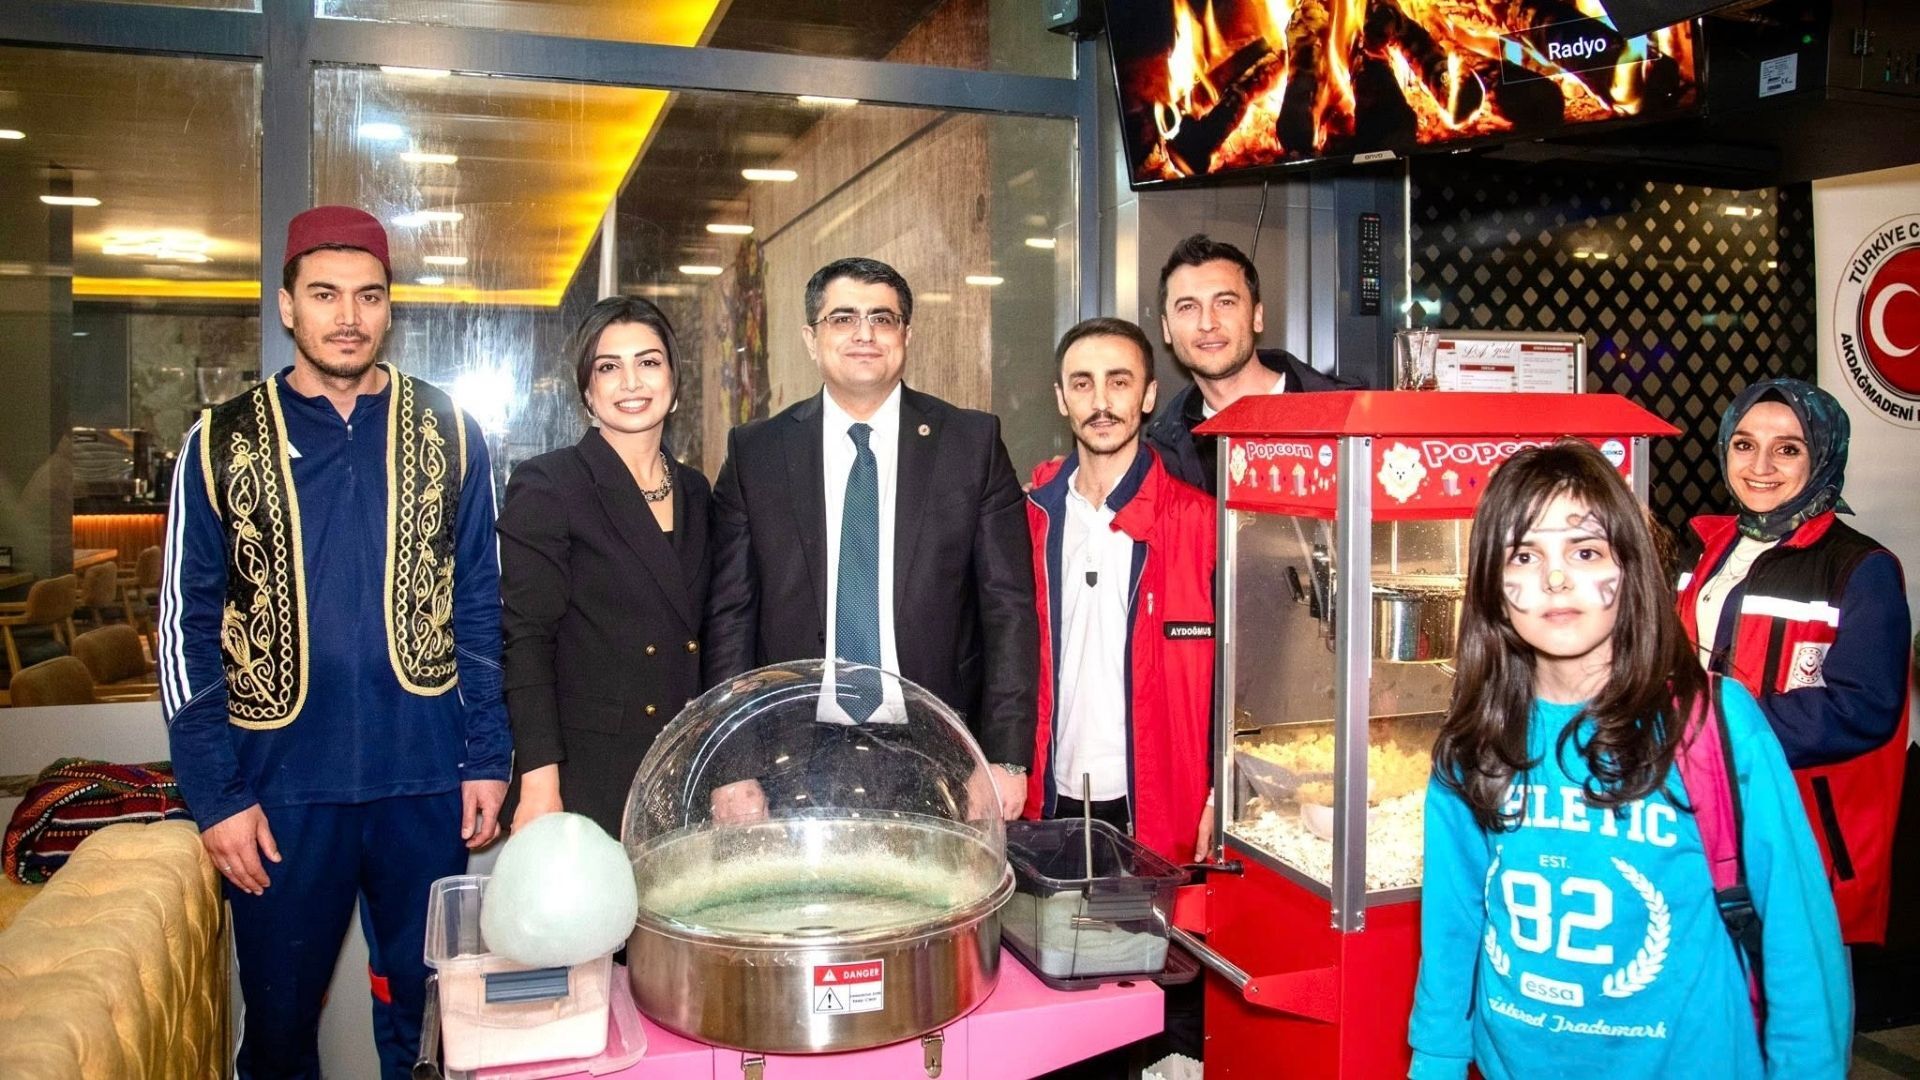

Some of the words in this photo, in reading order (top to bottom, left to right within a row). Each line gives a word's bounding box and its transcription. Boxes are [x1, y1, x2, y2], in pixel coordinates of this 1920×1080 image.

[1548, 36, 1606, 60] Radyo
[1849, 225, 1906, 285] TÜRKİYE
[1841, 332, 1913, 421] AKDAĞMADENİ
[1246, 441, 1313, 461] Popcorn
[1539, 854, 1570, 868] EST.
[1501, 869, 1614, 964] 82
[843, 968, 880, 979] DANGER
[1525, 979, 1574, 1000] essa
[1549, 1015, 1667, 1039] Trademark
